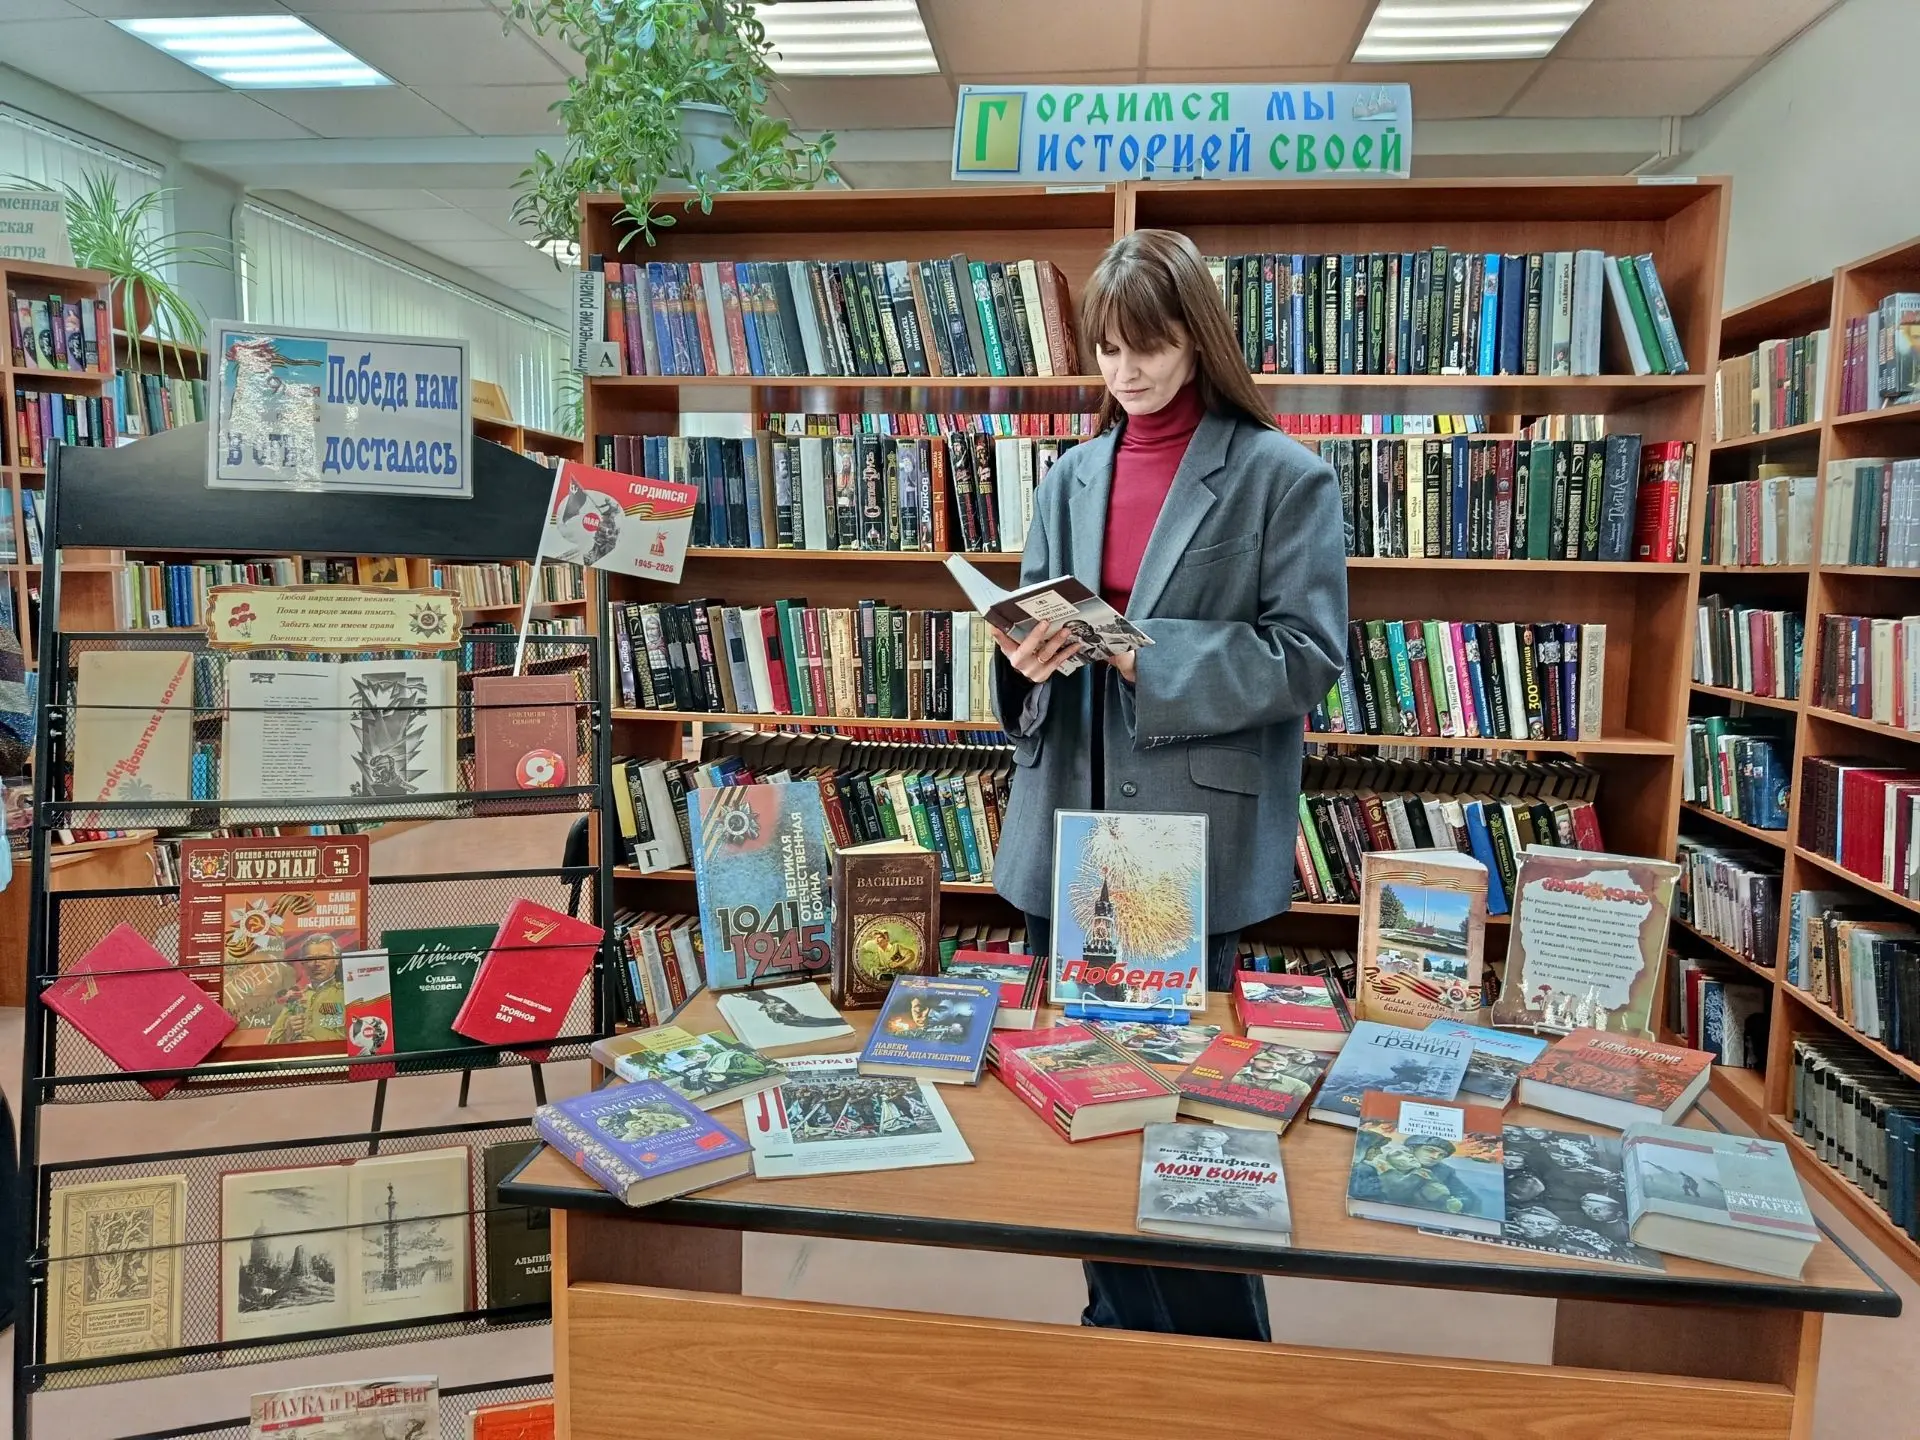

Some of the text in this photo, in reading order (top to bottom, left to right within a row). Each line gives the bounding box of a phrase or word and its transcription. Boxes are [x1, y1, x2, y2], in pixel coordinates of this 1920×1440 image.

[1266, 90, 1334, 121] МЫ
[1453, 284, 1462, 309] ГНЕВА
[1264, 282, 1273, 341] ДУЭЛЬ НА ТРОИХ
[901, 316, 912, 349] ТЕРРОРА
[908, 310, 920, 351] АНАТОМИЯ
[1452, 312, 1462, 337] ЧАША
[600, 352, 614, 367] А
[328, 352, 408, 413] Победа
[415, 373, 458, 410] нам
[791, 419, 802, 432] А
[322, 436, 457, 475] досталась
[628, 482, 688, 504] ГОРДИМСЯ!
[583, 518, 599, 527] МАЯ
[151, 614, 161, 628] В
[276, 607, 299, 615] Пока
[280, 620, 311, 628] Забыть
[1363, 682, 1377, 730] ВЕЩИЙ ОЛЕГ
[1528, 684, 1541, 711] 300
[124, 714, 162, 776] ДОБЫТЫЕ
[525, 757, 555, 785] 9
[235, 848, 317, 860] ВОЕННО-ИСТОРИЧЕСКИЙ
[236, 858, 316, 879] ЖУРНАЛ
[342, 854, 350, 867] 5
[781, 834, 797, 898] ВЕЛИКАЯ
[792, 811, 812, 922] ОТЕЧЕСТВЕННАЯ
[857, 875, 924, 888] ВАСИЛЬЕВ
[328, 891, 357, 902] СЛАВА
[808, 871, 824, 921] ВОЙНА
[1603, 887, 1650, 906] 1945
[297, 915, 356, 928] ПОБЕДИТЕЛЮ!
[716, 899, 802, 953] 1941
[731, 923, 832, 980] 1945
[418, 982, 462, 992] человека
[425, 974, 457, 984] Судьба
[1061, 959, 1198, 991] Победа!
[156, 1003, 205, 1048] ФРОНТОВЫЕ
[495, 1012, 513, 1025] ВАЛ
[499, 1004, 537, 1023] ТРОЯНОВ
[162, 1029, 190, 1054] СТИХИ
[874, 1041, 909, 1051] НАВЕКИ
[1588, 1038, 1599, 1048] В
[1599, 1039, 1649, 1059] КАЖДОМ
[1647, 1051, 1682, 1065] ДОМЕ
[846, 1057, 854, 1066] В
[871, 1048, 972, 1063] ДЕВЯТНАДЦАТИЛЕТНИЕ
[580, 1092, 667, 1120] СИМОНОВ
[1153, 1162, 1278, 1185] МОЯ ВОЙНА
[1176, 1153, 1271, 1169] Астафьев
[1726, 1194, 1805, 1215] БАТАРЕЯ
[1501, 1239, 1568, 1254] ВЕЛИКОЙ
[263, 1395, 325, 1421] НАУКА
